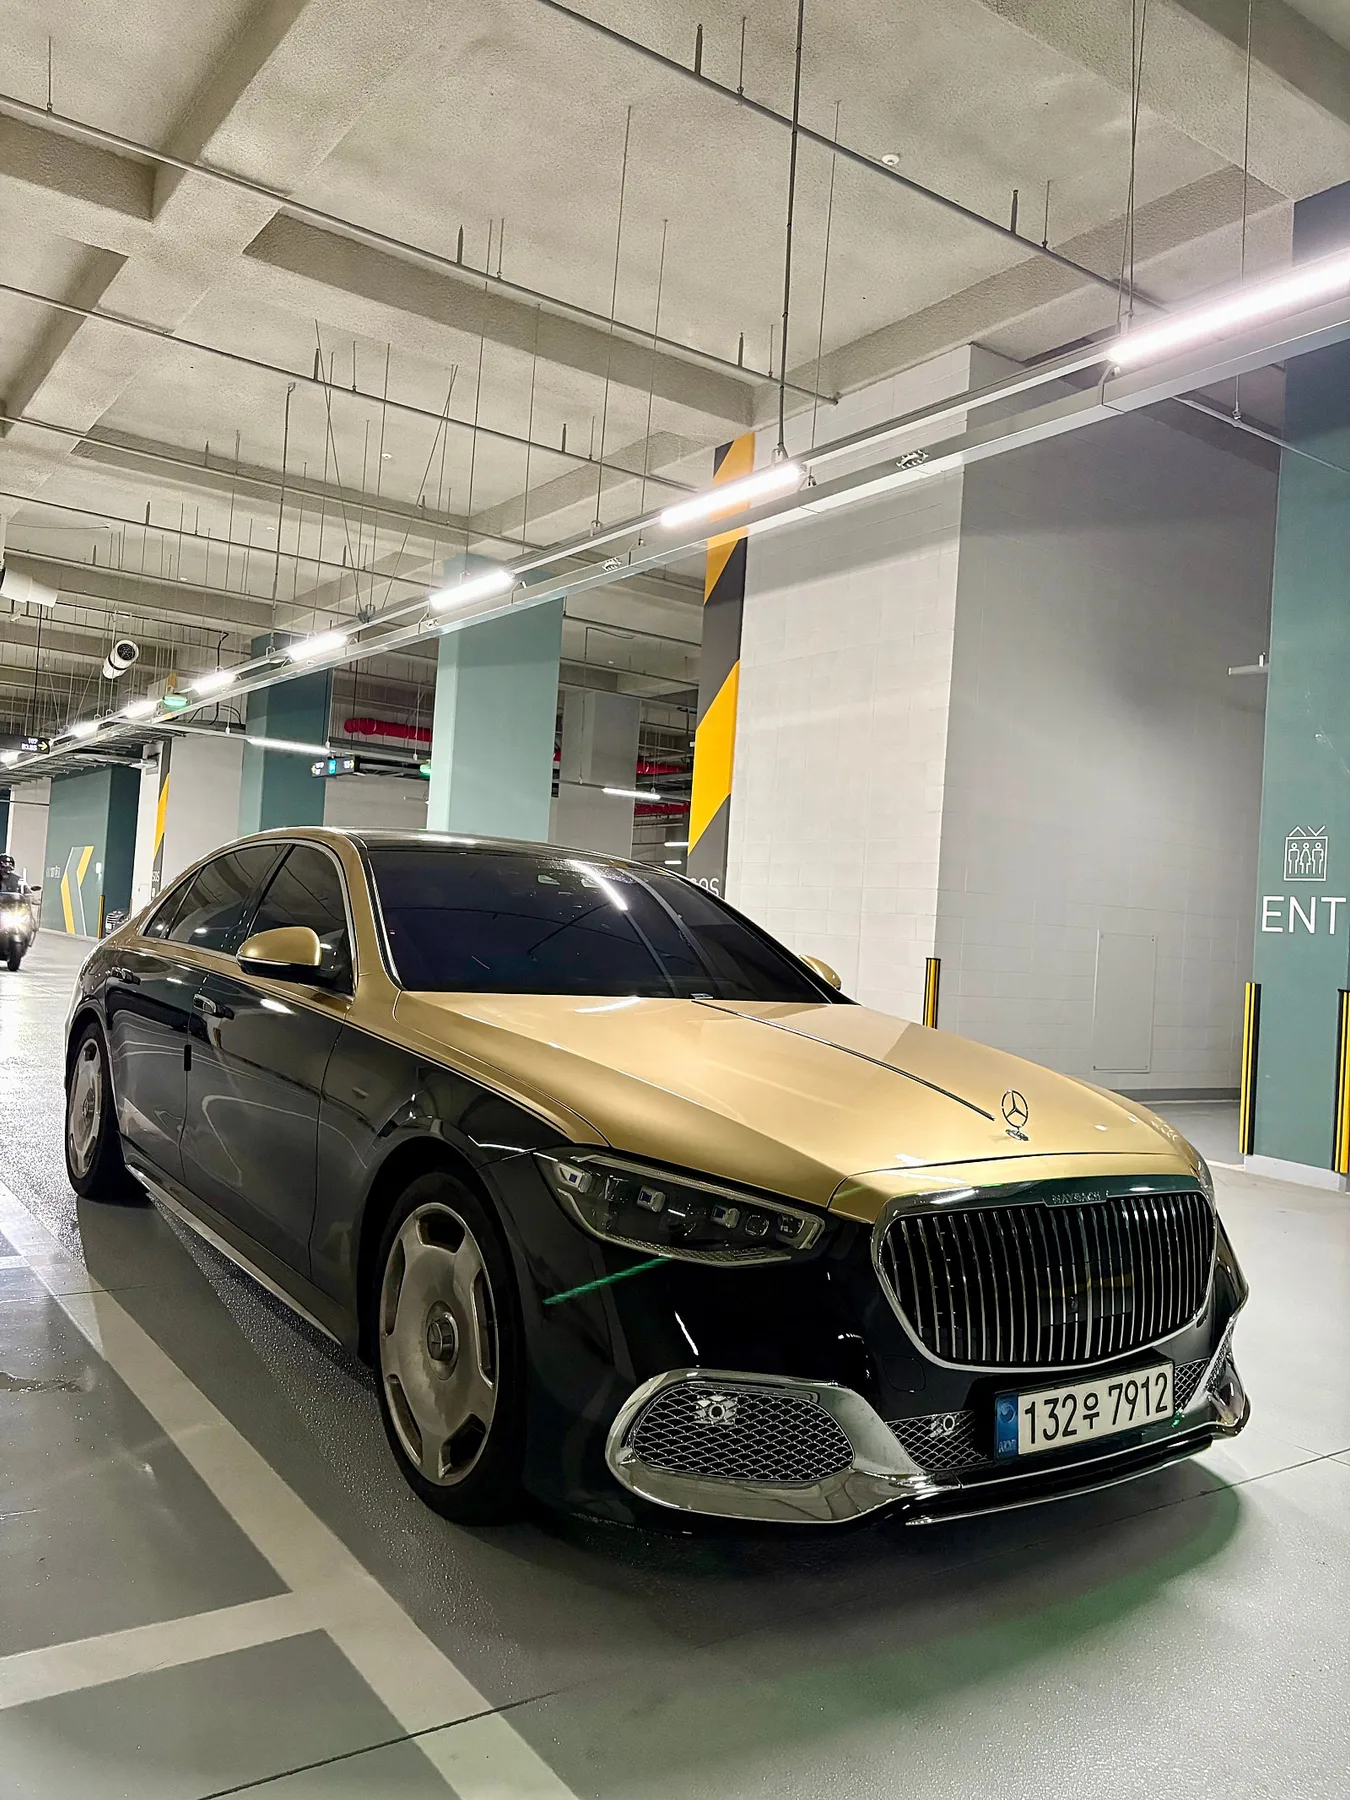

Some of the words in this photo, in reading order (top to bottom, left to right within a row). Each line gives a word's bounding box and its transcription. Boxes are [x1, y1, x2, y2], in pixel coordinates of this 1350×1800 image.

[1261, 895, 1347, 935] ENT
[1024, 1393, 1100, 1445] 132우
[1108, 1372, 1168, 1426] 7912
